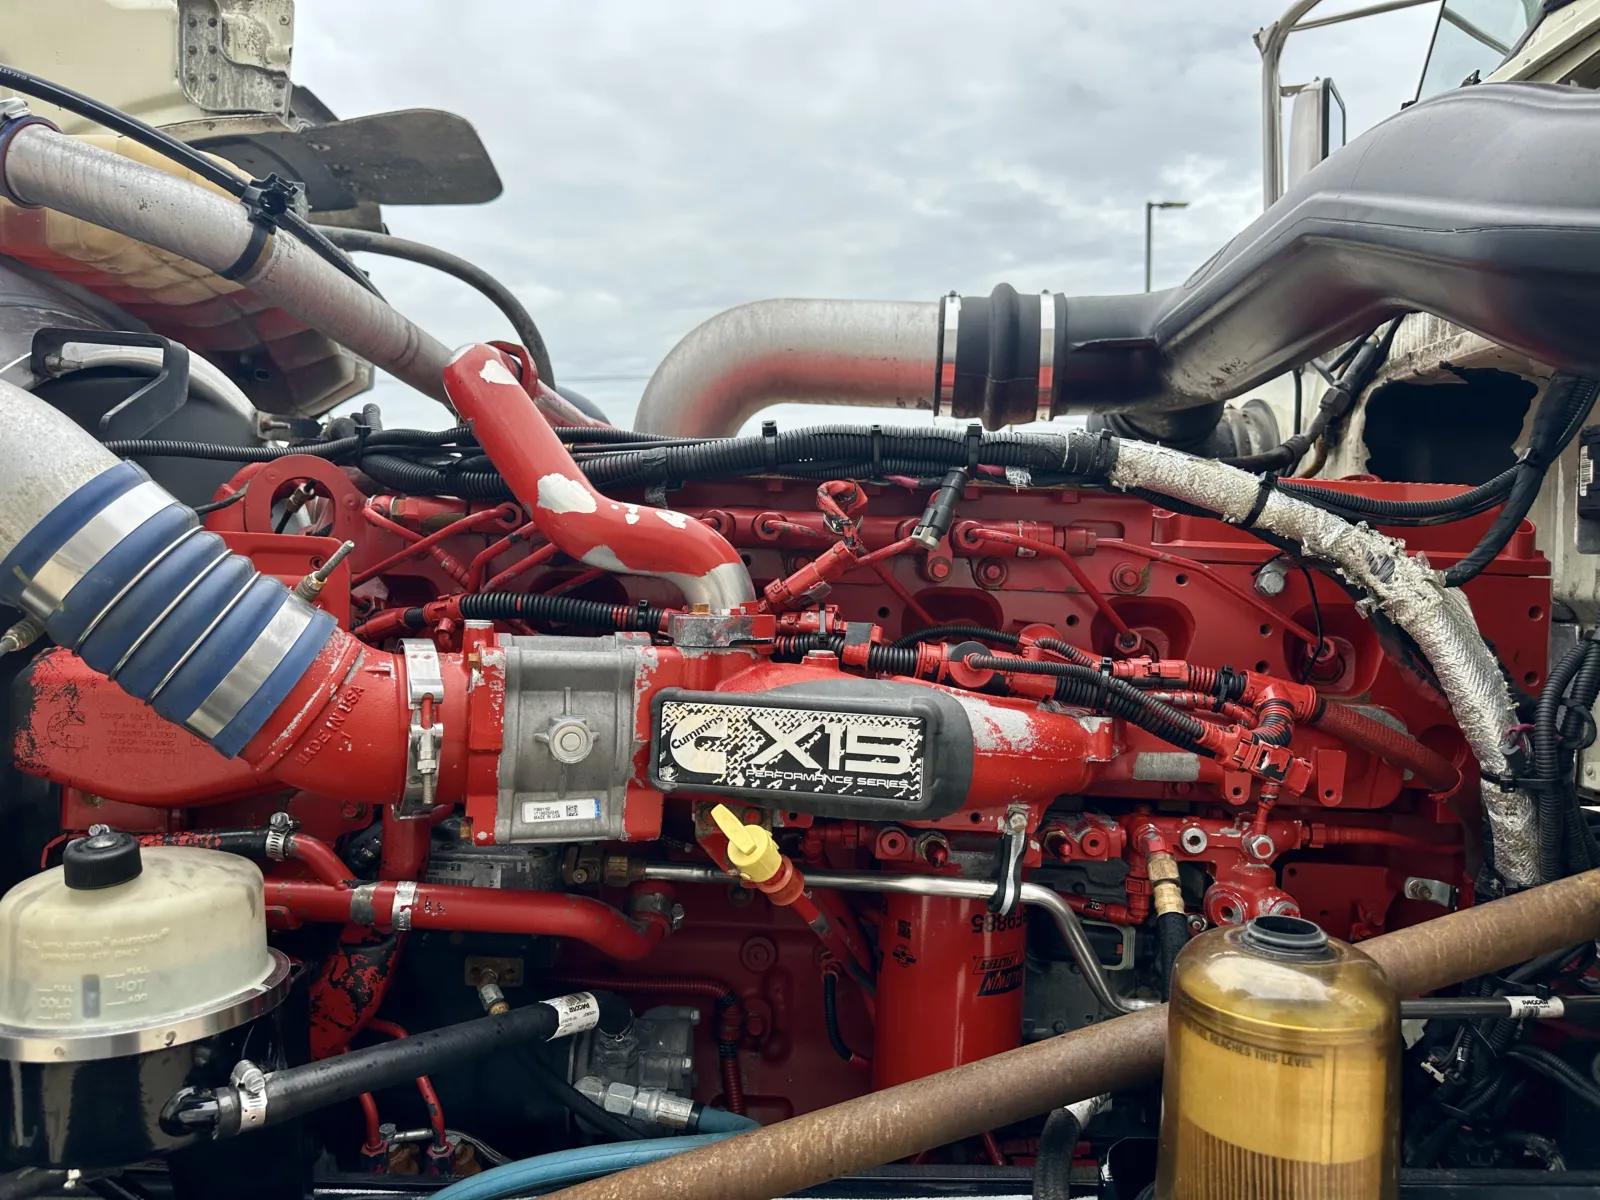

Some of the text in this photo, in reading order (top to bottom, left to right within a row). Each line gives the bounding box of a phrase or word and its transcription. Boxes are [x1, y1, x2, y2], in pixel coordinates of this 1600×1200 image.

[338, 685, 366, 713] USA
[670, 715, 724, 750] Cummins
[749, 714, 912, 775] X15
[746, 769, 909, 789] PERFORMANCE SERIES
[116, 978, 146, 992] HOT
[39, 997, 73, 1009] COLD
[569, 1002, 591, 1013] PACCAR
[1210, 1031, 1251, 1057] REACHES
[1255, 1047, 1278, 1064] THIS
[1281, 1051, 1313, 1069] LEVEL
